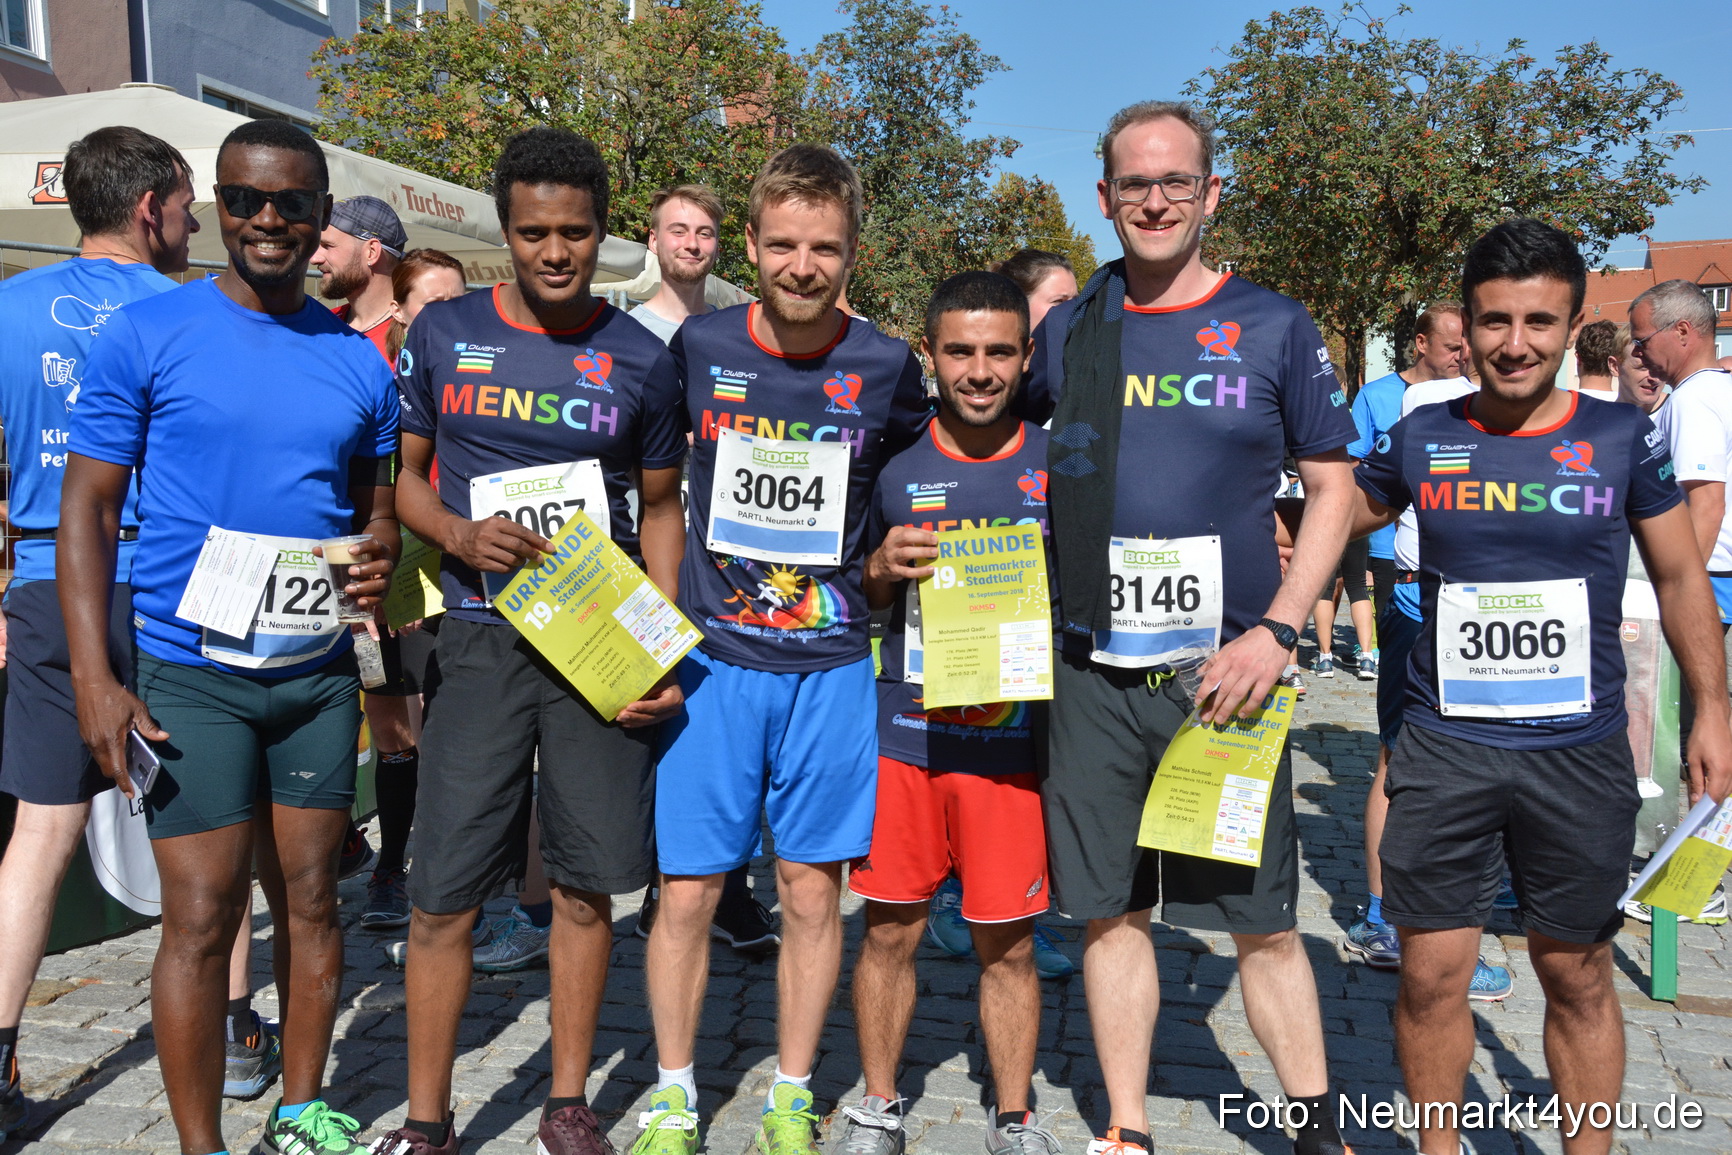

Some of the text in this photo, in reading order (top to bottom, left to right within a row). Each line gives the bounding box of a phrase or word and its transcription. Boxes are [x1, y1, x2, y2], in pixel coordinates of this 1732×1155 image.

[401, 184, 465, 223] Tucher
[1124, 373, 1247, 409] NSCH
[441, 384, 618, 436] MENSCH
[701, 409, 865, 458] MENSCH
[753, 447, 809, 465] BOCK
[504, 476, 564, 496] BOCK
[733, 467, 825, 512] 3064
[1420, 481, 1614, 517] MENSCH
[737, 510, 804, 526] PARTL Neumarkt
[939, 533, 1036, 558] RKUNDE
[278, 550, 317, 566] OCK
[505, 522, 593, 612] URKUNDE
[1123, 550, 1181, 565] BOCK
[549, 540, 605, 597] Neumarkter
[933, 559, 1038, 590] 19. Neumarkter
[966, 571, 1024, 586] Stadtlauf
[557, 559, 605, 605] Stadtlauf
[264, 574, 332, 616] 122
[568, 572, 612, 615] 16. September 2018
[976, 590, 1009, 598] September
[1478, 594, 1544, 609] BOCK
[524, 601, 561, 631] 19.
[577, 606, 594, 624] DKMS
[969, 603, 990, 612] DKMS
[269, 620, 310, 630] Neumarkt
[1112, 618, 1181, 628] PARTL Neumarkt
[1459, 619, 1566, 661] 3066
[1469, 666, 1546, 675] PARTL Neumarkt
[1212, 721, 1267, 741] Stadtlauf
[1205, 749, 1224, 758] DKMS
[1217, 738, 1246, 749] September
[1246, 743, 1259, 751] 2018
[1171, 765, 1212, 777] Mathias Schmidt
[129, 797, 145, 817] La
